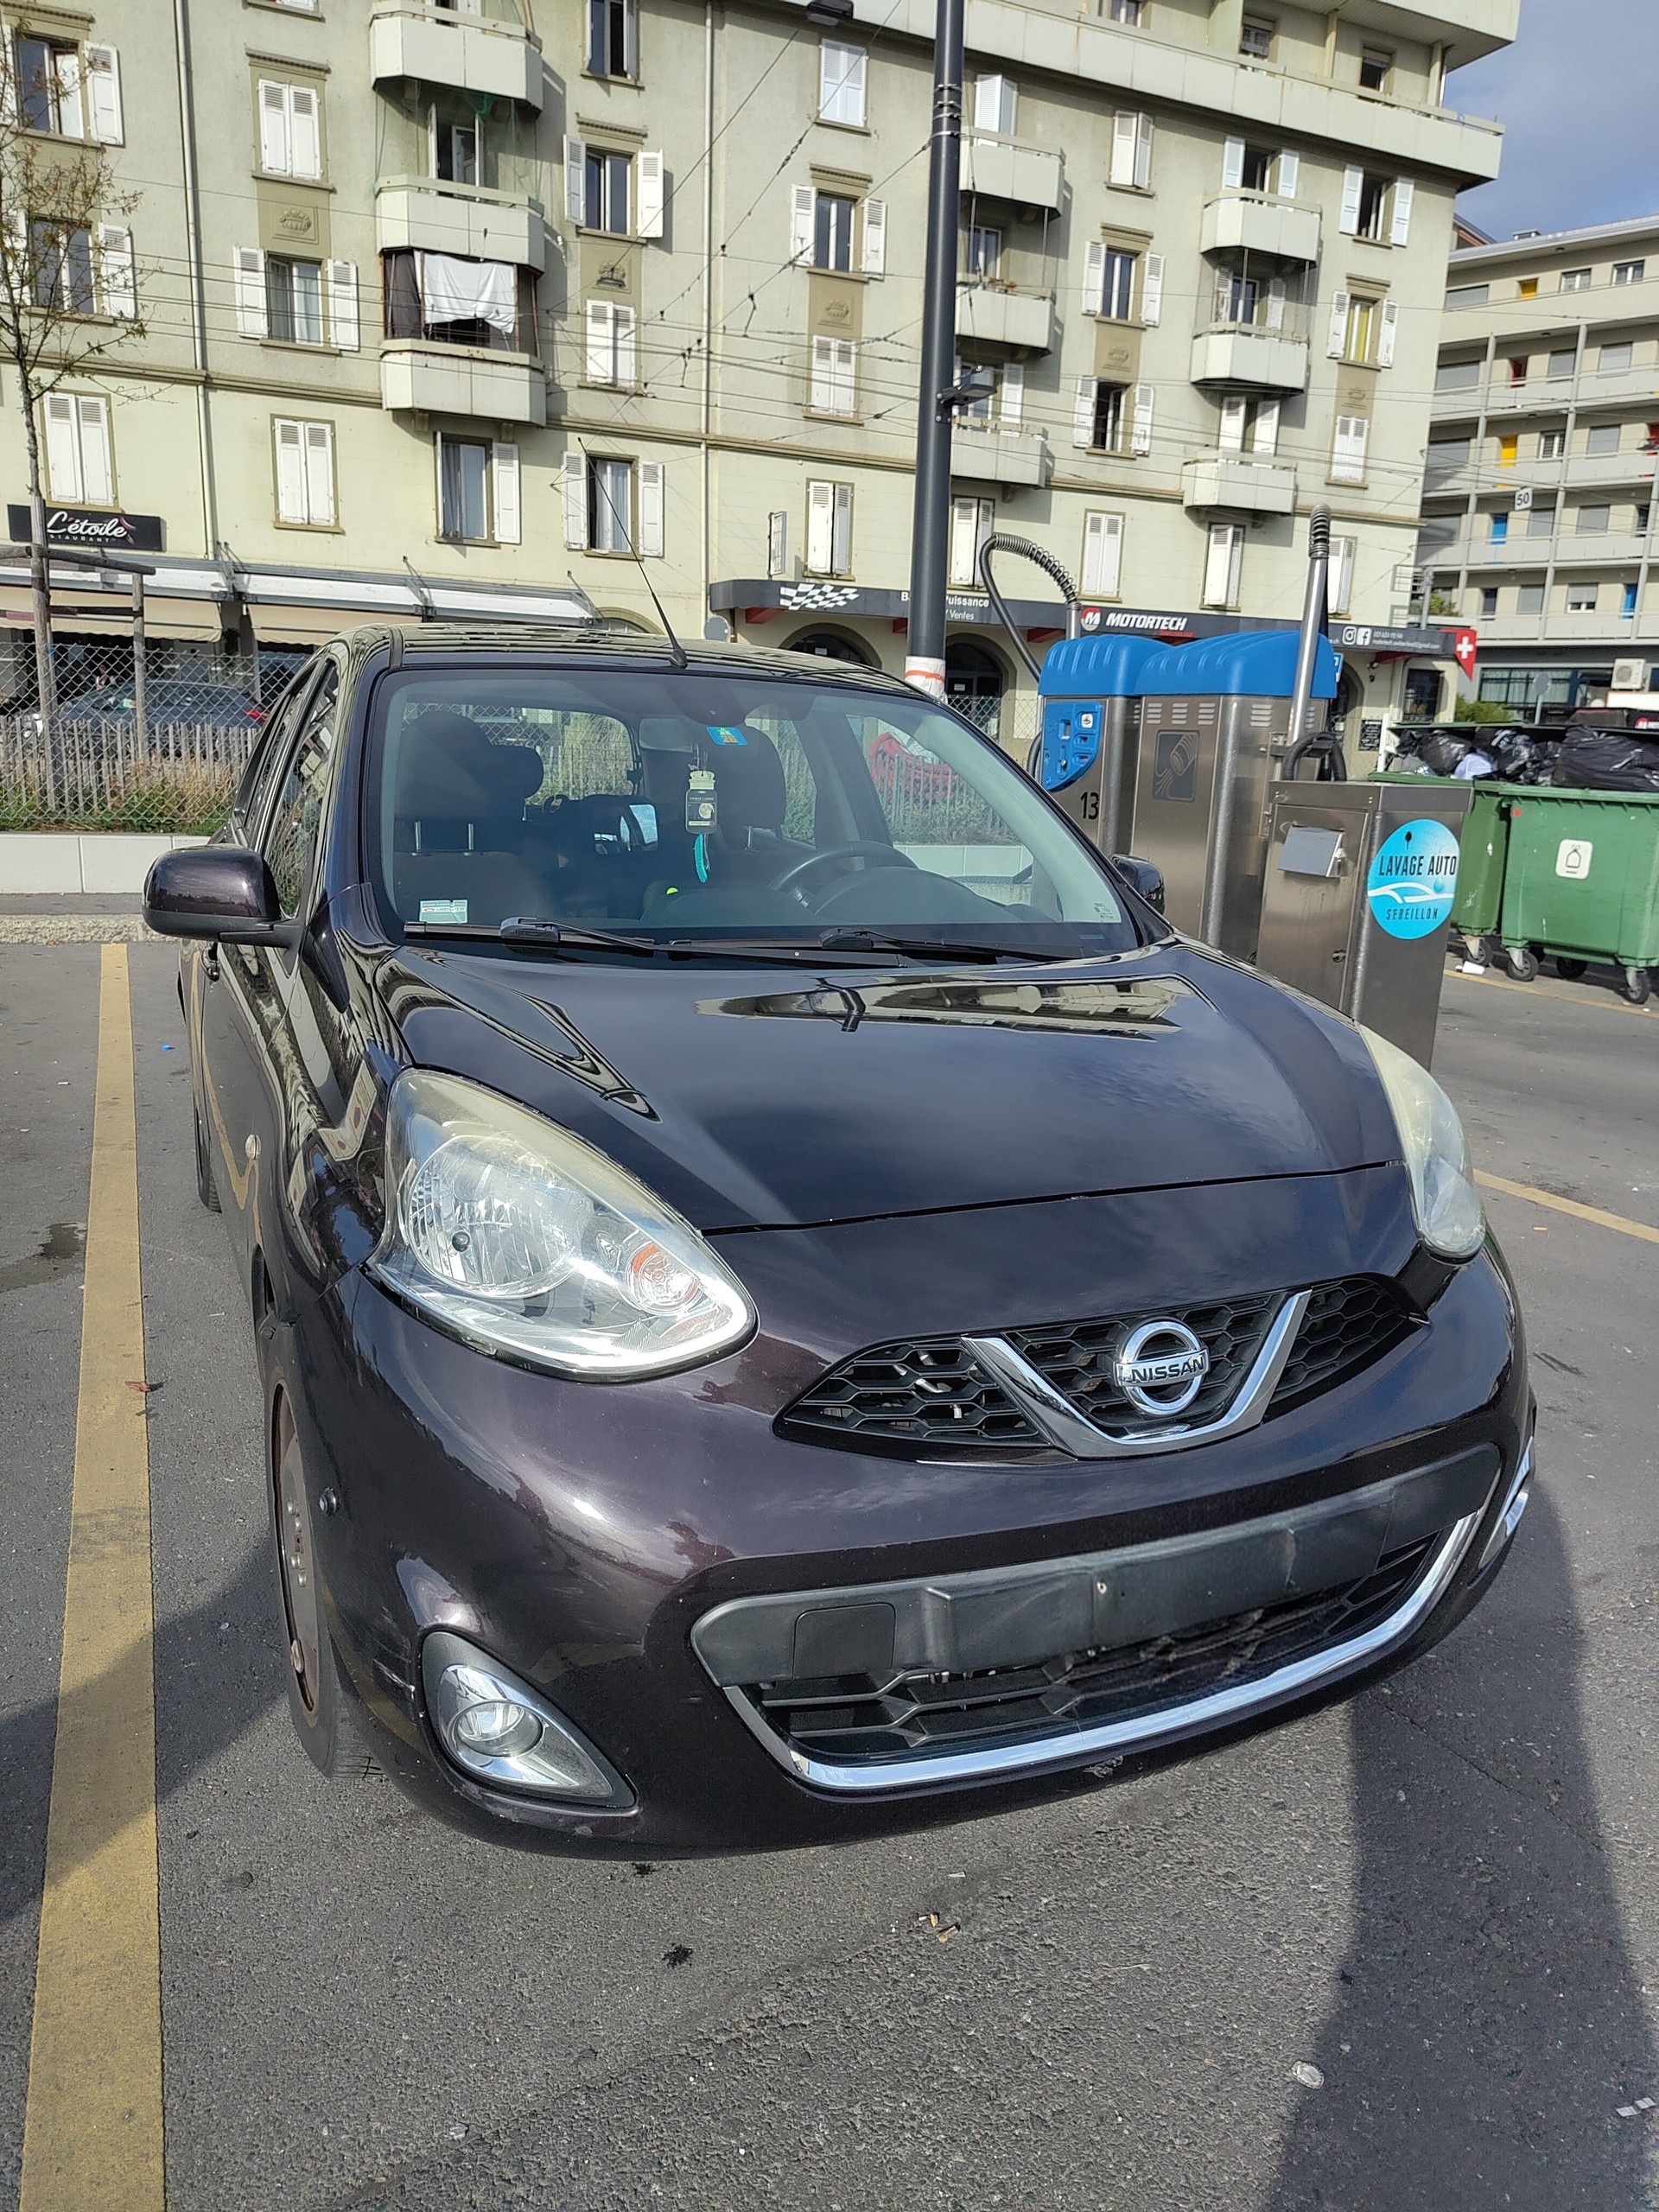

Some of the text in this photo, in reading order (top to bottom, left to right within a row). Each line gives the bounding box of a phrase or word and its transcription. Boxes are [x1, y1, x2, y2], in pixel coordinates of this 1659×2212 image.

[1516, 493, 1529, 506] 50
[49, 534, 111, 543] STAURANT
[950, 609, 976, 621] Ventes
[1106, 612, 1188, 632] MOTORTECH
[1080, 791, 1100, 820] 13
[1379, 856, 1457, 875] LAVAGE AUTO
[1131, 1357, 1205, 1382] NISSAN
